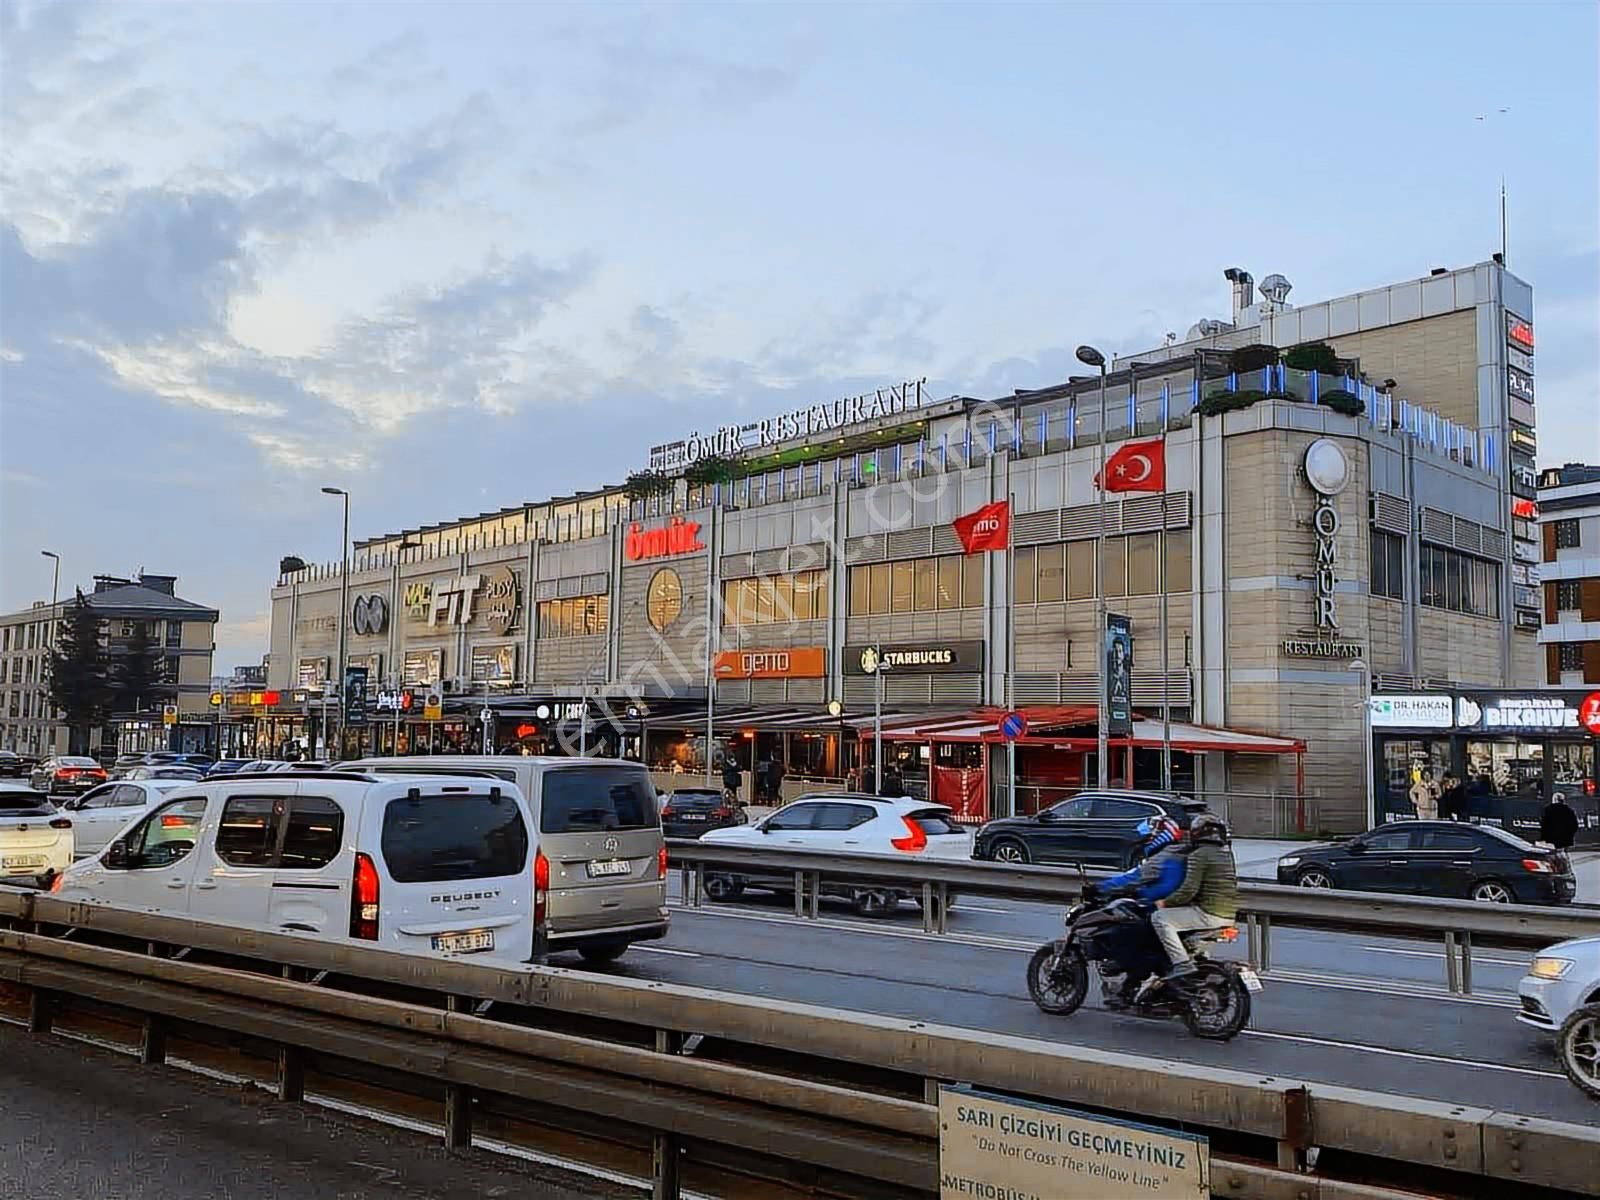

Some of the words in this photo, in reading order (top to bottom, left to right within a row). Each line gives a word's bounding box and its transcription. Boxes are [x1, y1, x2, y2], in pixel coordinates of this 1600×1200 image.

[686, 425, 743, 463] ÖMÜR
[758, 377, 927, 447] RESTAURANT
[1314, 498, 1340, 629] ÖMÜR
[883, 649, 952, 666] STARBUCKS
[1284, 640, 1364, 658] RESTAURANT
[1412, 700, 1450, 710] HAKAN
[430, 890, 500, 903] PEUGEOT
[956, 1105, 994, 1129] SARI
[1000, 1115, 1062, 1144] ÇİZGİYİ
[1067, 1129, 1186, 1170] GEÇMEYİNİZ
[998, 1141, 1022, 1158] Not
[1024, 1147, 1057, 1167] Cross
[1061, 1155, 1084, 1172] The
[1087, 1160, 1129, 1183] Yellow
